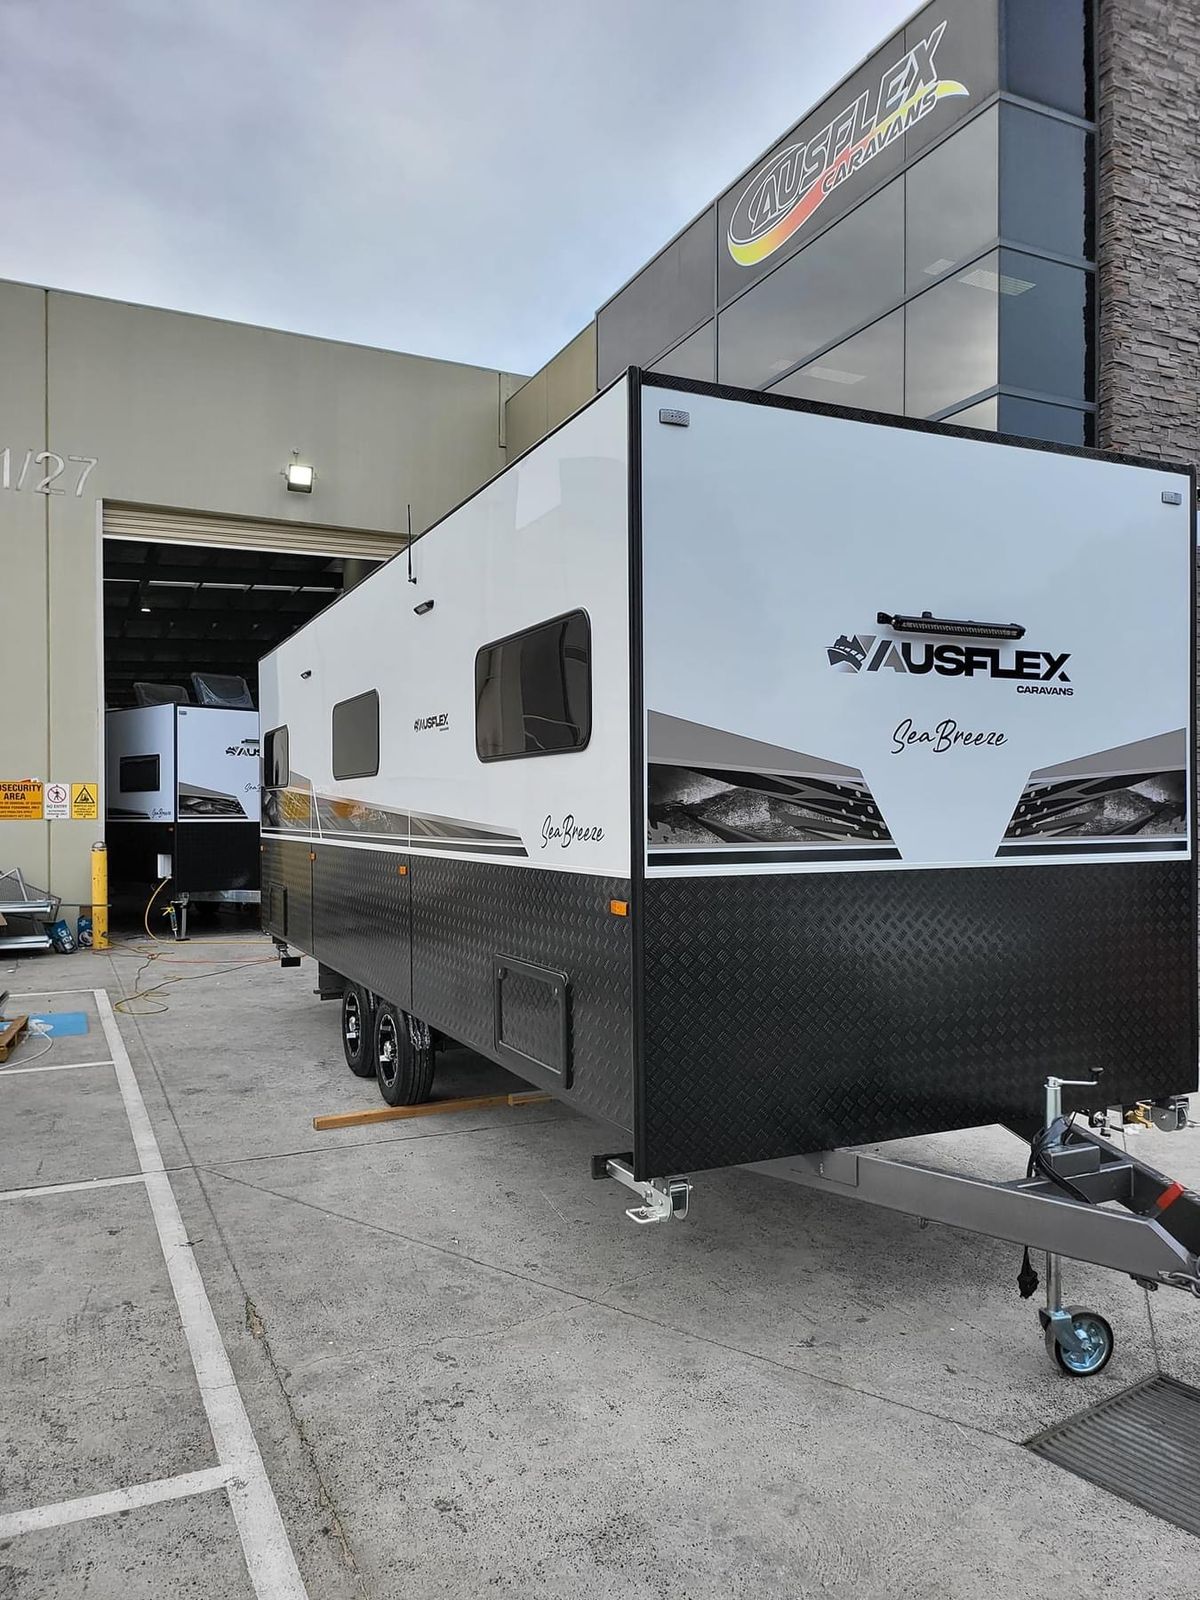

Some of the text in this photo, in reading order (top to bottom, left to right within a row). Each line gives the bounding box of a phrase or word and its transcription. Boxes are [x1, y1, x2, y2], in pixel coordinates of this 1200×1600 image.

[750, 20, 947, 234] AUSFLEX
[821, 91, 938, 194] CARAVANS
[867, 640, 1071, 682] AUSFLEX
[1016, 685, 1074, 696] CARAVANS
[0, 784, 41, 792] SECURITY
